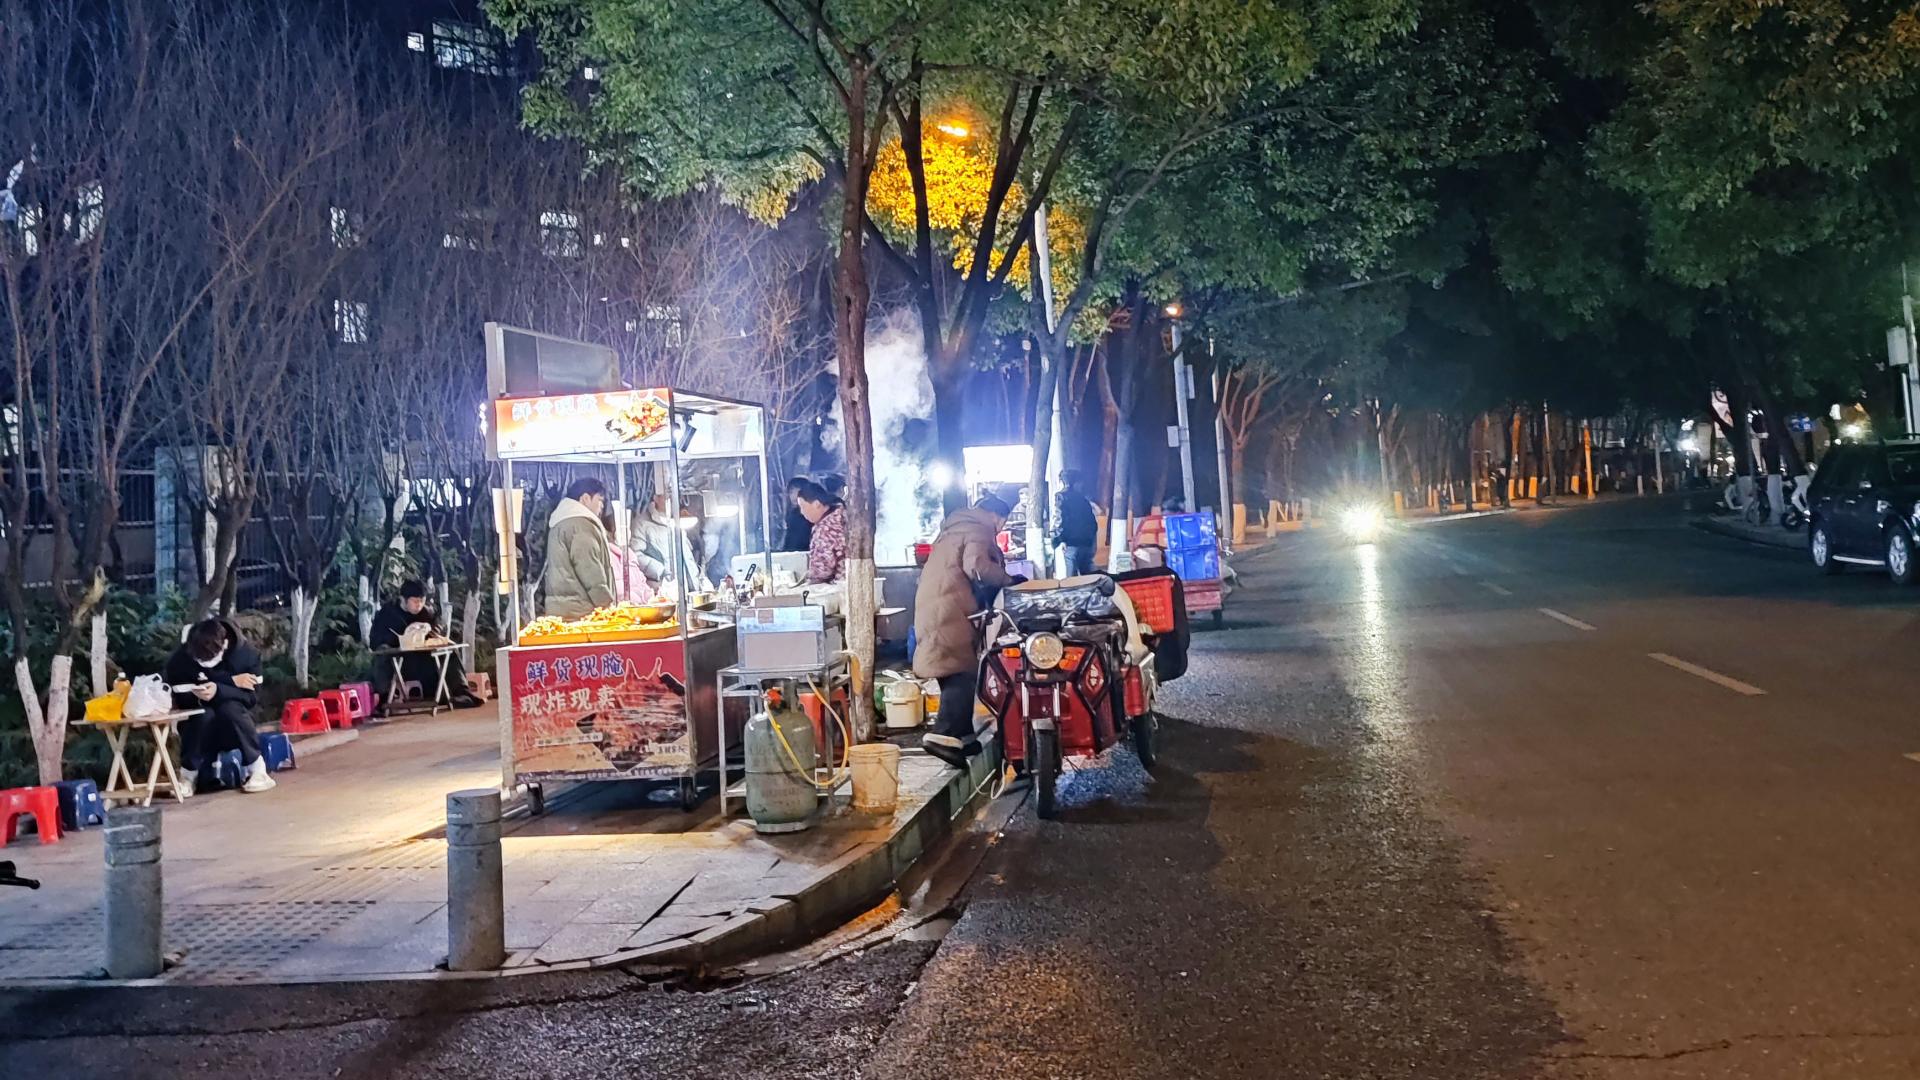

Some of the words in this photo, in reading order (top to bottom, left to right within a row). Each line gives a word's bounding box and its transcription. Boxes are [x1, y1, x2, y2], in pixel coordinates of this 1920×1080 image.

[526, 652, 625, 688] 鲜货现腌
[520, 685, 616, 717] 现炸现卖
